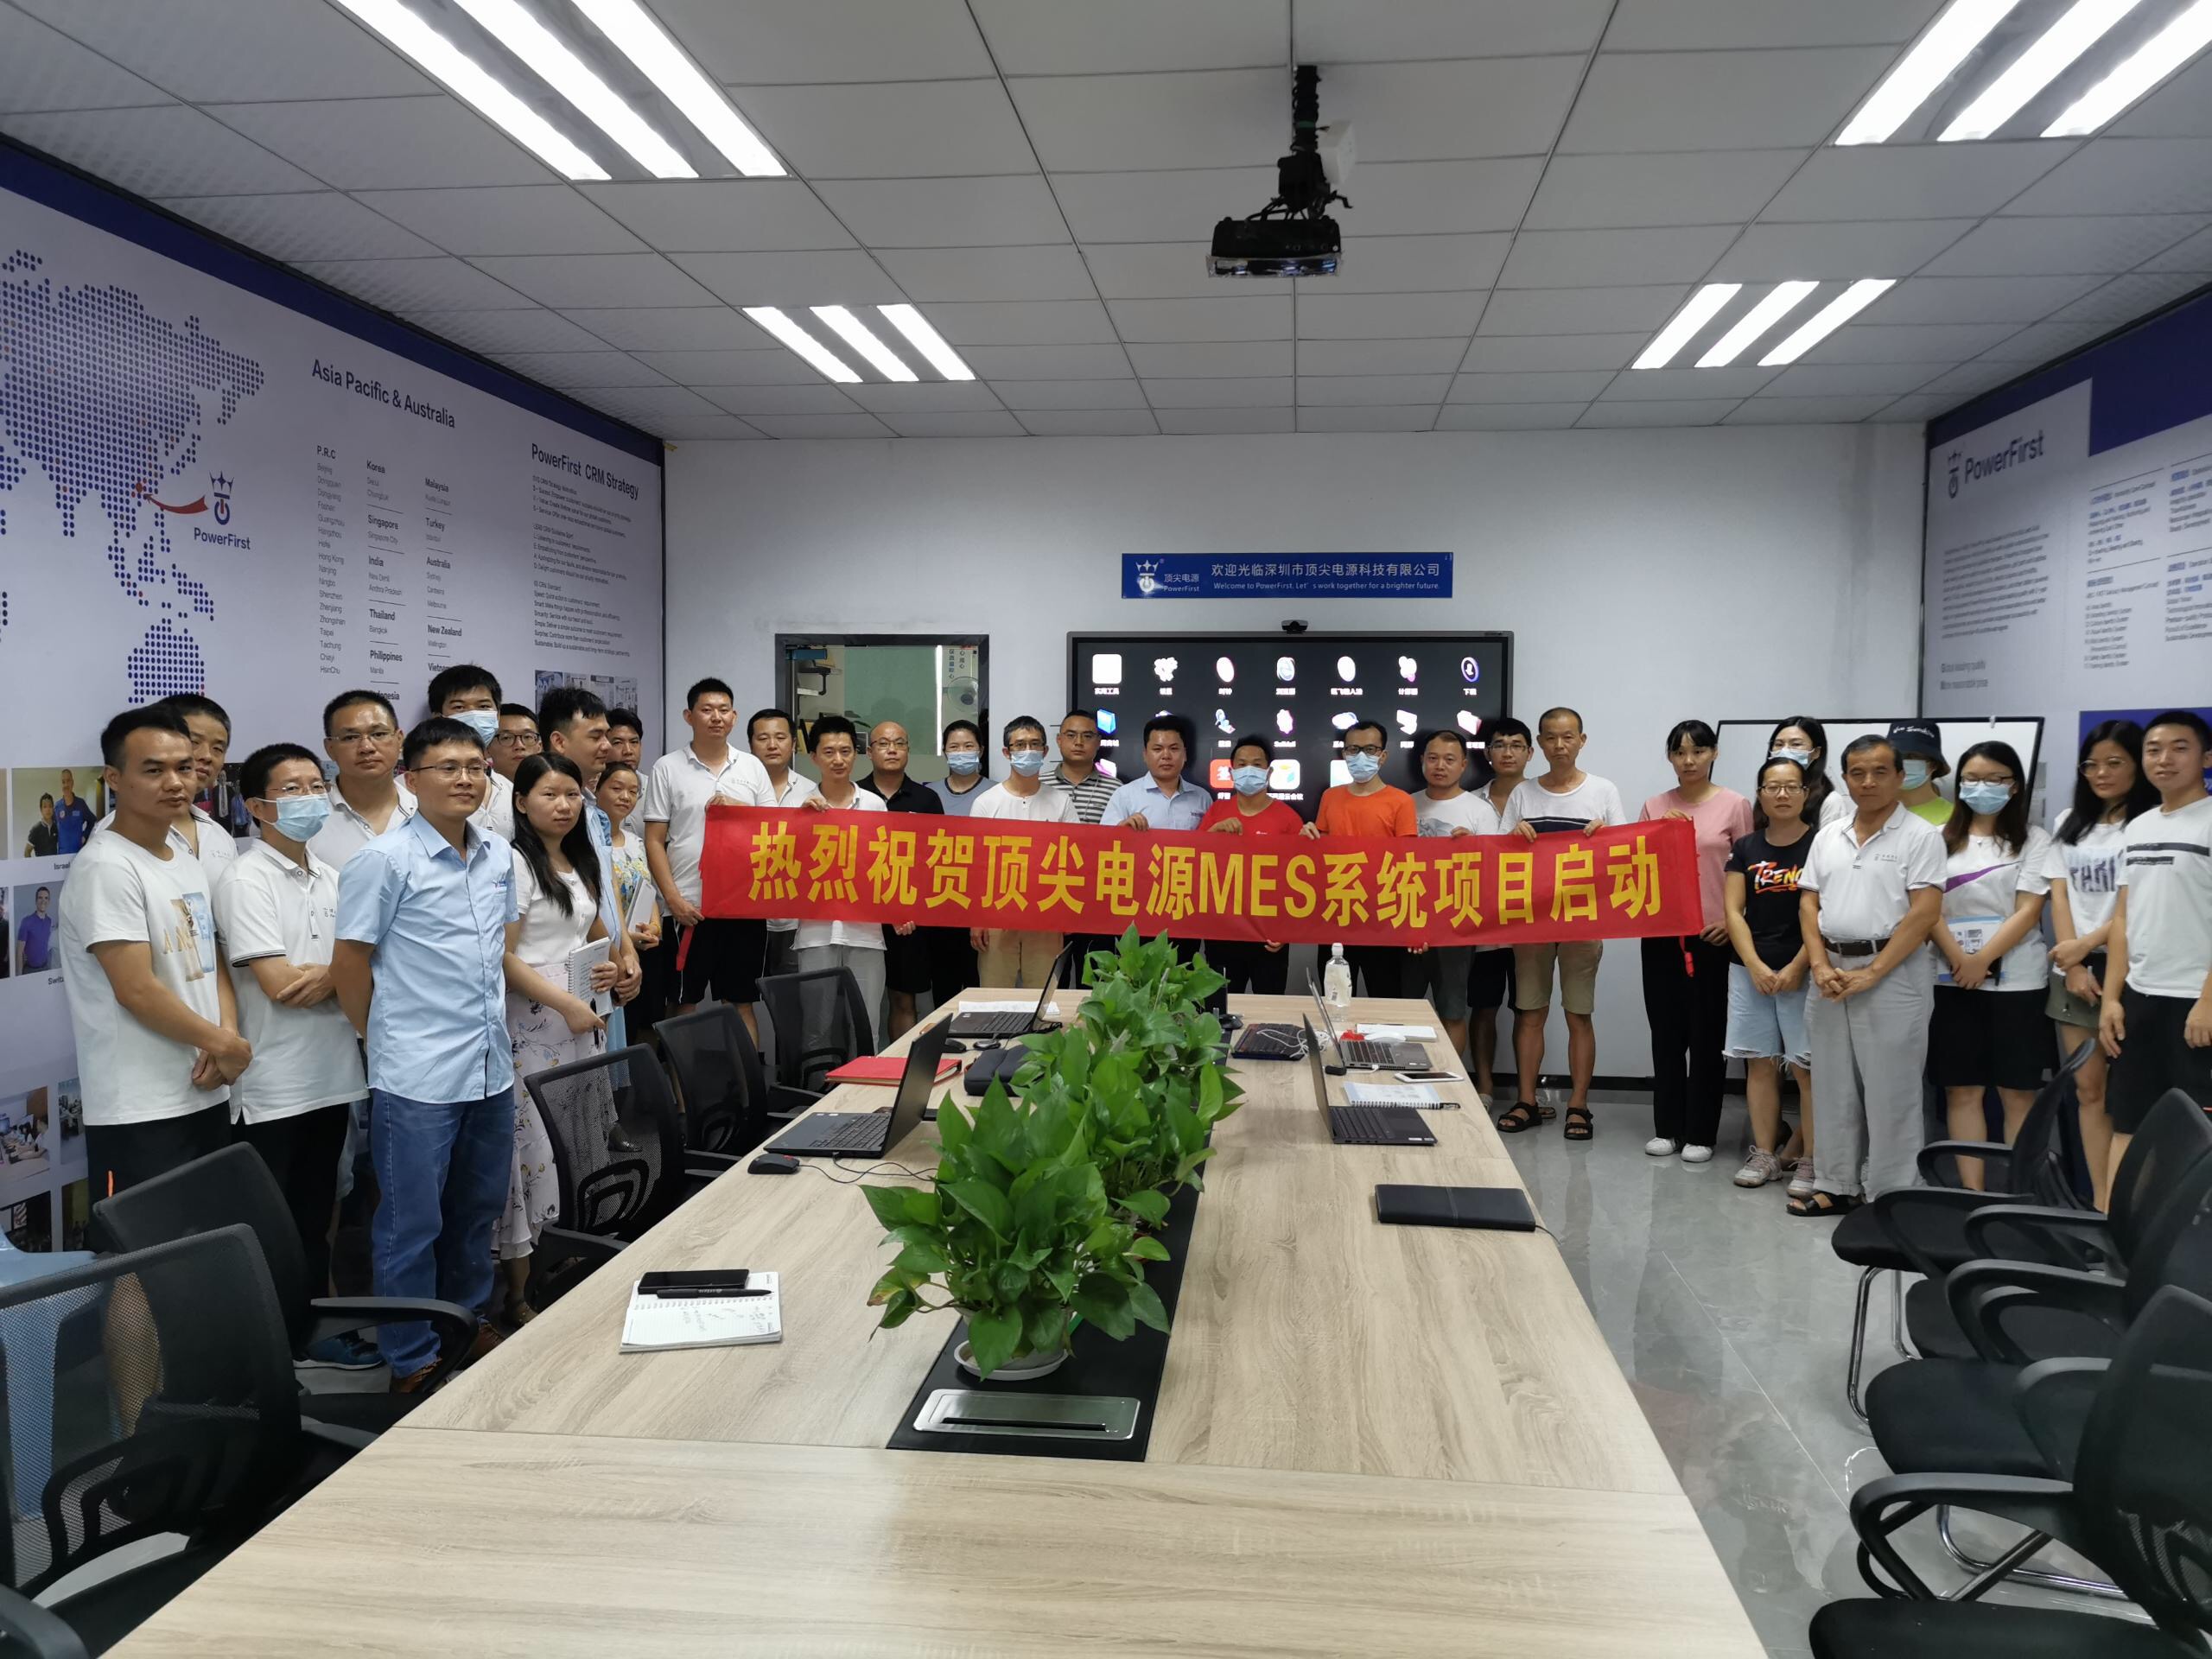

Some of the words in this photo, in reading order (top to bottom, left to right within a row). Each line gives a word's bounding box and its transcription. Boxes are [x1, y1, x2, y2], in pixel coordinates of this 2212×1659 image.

[312, 359, 342, 386] Asia
[346, 371, 390, 404] Pacific
[392, 390, 402, 408] &
[404, 395, 455, 428] Australia
[1965, 429, 2044, 484] PowerFirst
[367, 460, 385, 474] Korea
[531, 442, 582, 476] PowerFirst
[585, 464, 605, 485] CRM
[606, 472, 639, 500] Strategy
[425, 478, 448, 492] Malaysia
[368, 514, 398, 530] Singapore
[425, 518, 445, 531] Turkey
[194, 527, 251, 550] PowerFirst
[369, 555, 384, 567] India
[427, 556, 450, 569] Australia
[1211, 563, 1440, 576] 欢迎光临深圳市顶尖电源科技有限公司
[1164, 573, 1199, 583] 顶尖电源
[1337, 582, 1368, 591] together
[1386, 582, 1415, 591] brighter
[369, 608, 395, 620] Thailand
[428, 625, 440, 634] New
[441, 626, 462, 636] Zealand
[370, 650, 403, 662] Philippines
[428, 663, 450, 671] Vietna
[54, 861, 71, 870] Israel
[748, 821, 1661, 929] 热烈祝贺顶尖电源MES系统项目启动
